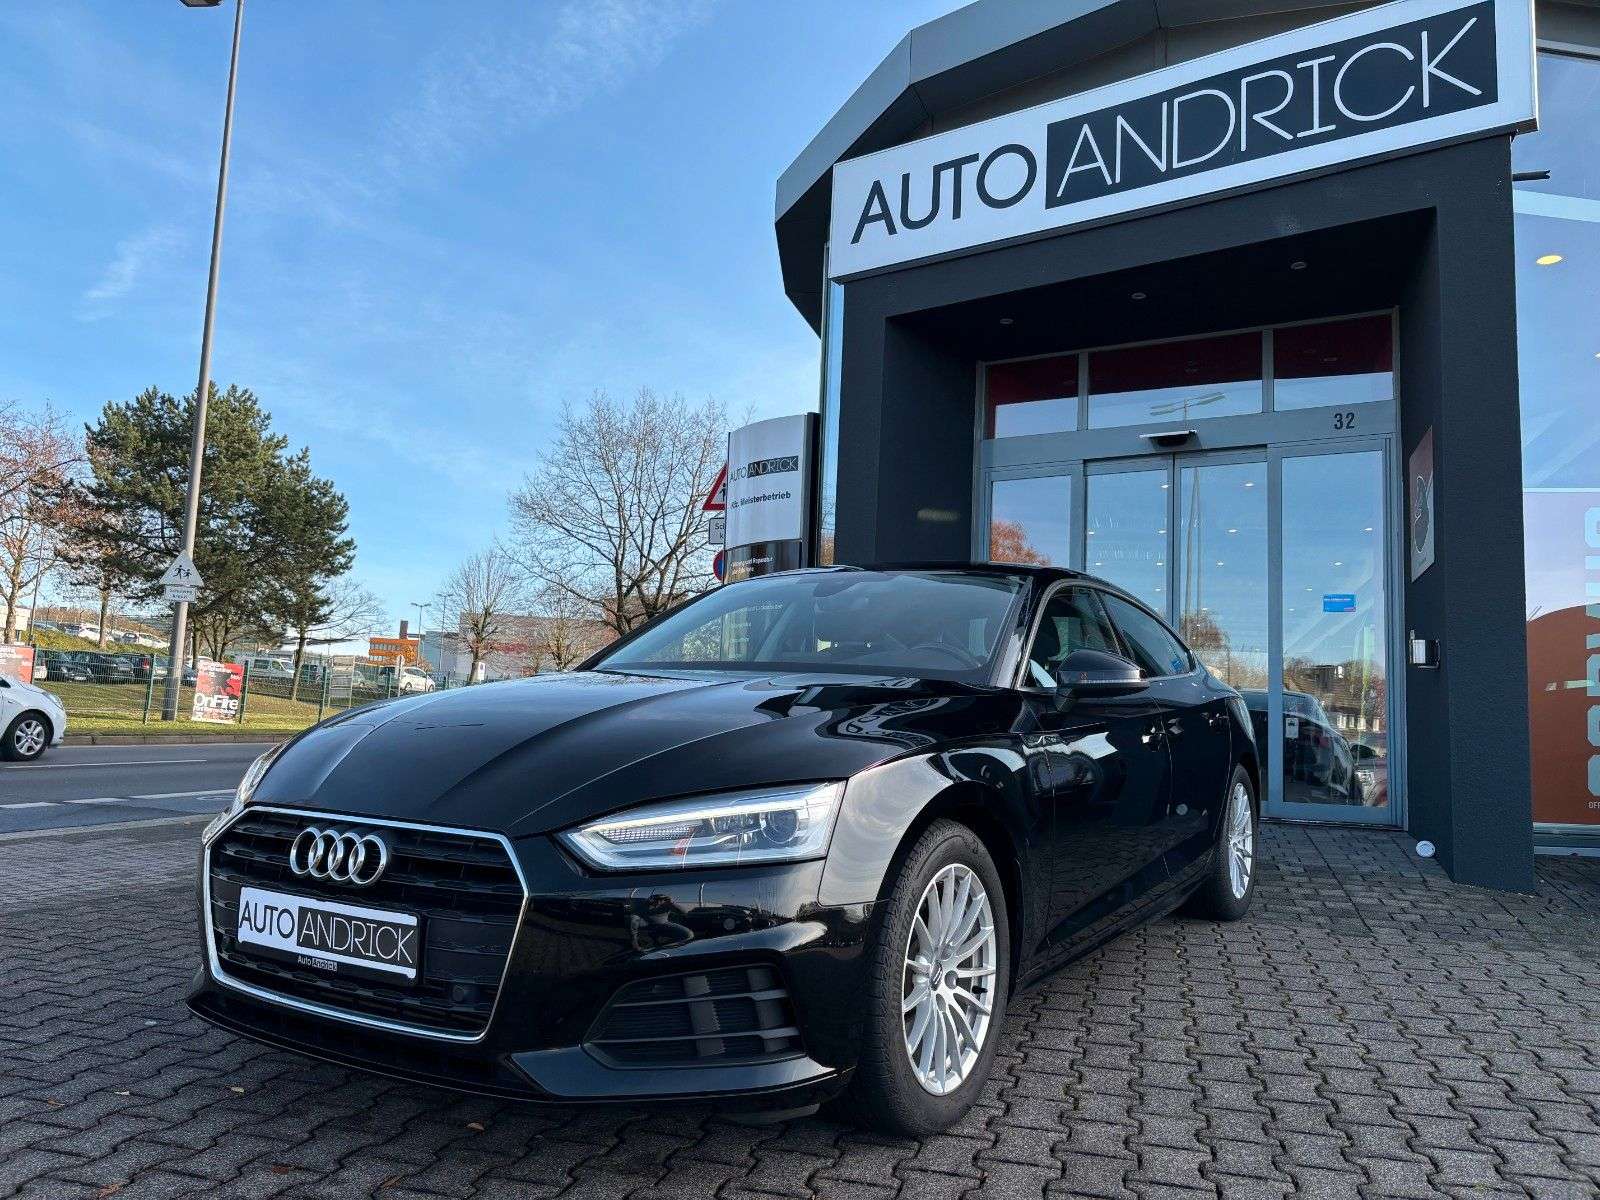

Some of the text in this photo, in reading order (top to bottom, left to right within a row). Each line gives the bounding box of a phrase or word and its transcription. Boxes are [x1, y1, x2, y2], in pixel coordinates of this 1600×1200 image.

[850, 17, 1482, 245] AUTO ANDRICK
[1333, 412, 1355, 430] 32
[748, 457, 797, 477] ANDRICK
[239, 900, 415, 964] AUTO ANDRICK
[297, 955, 312, 968] Auto
